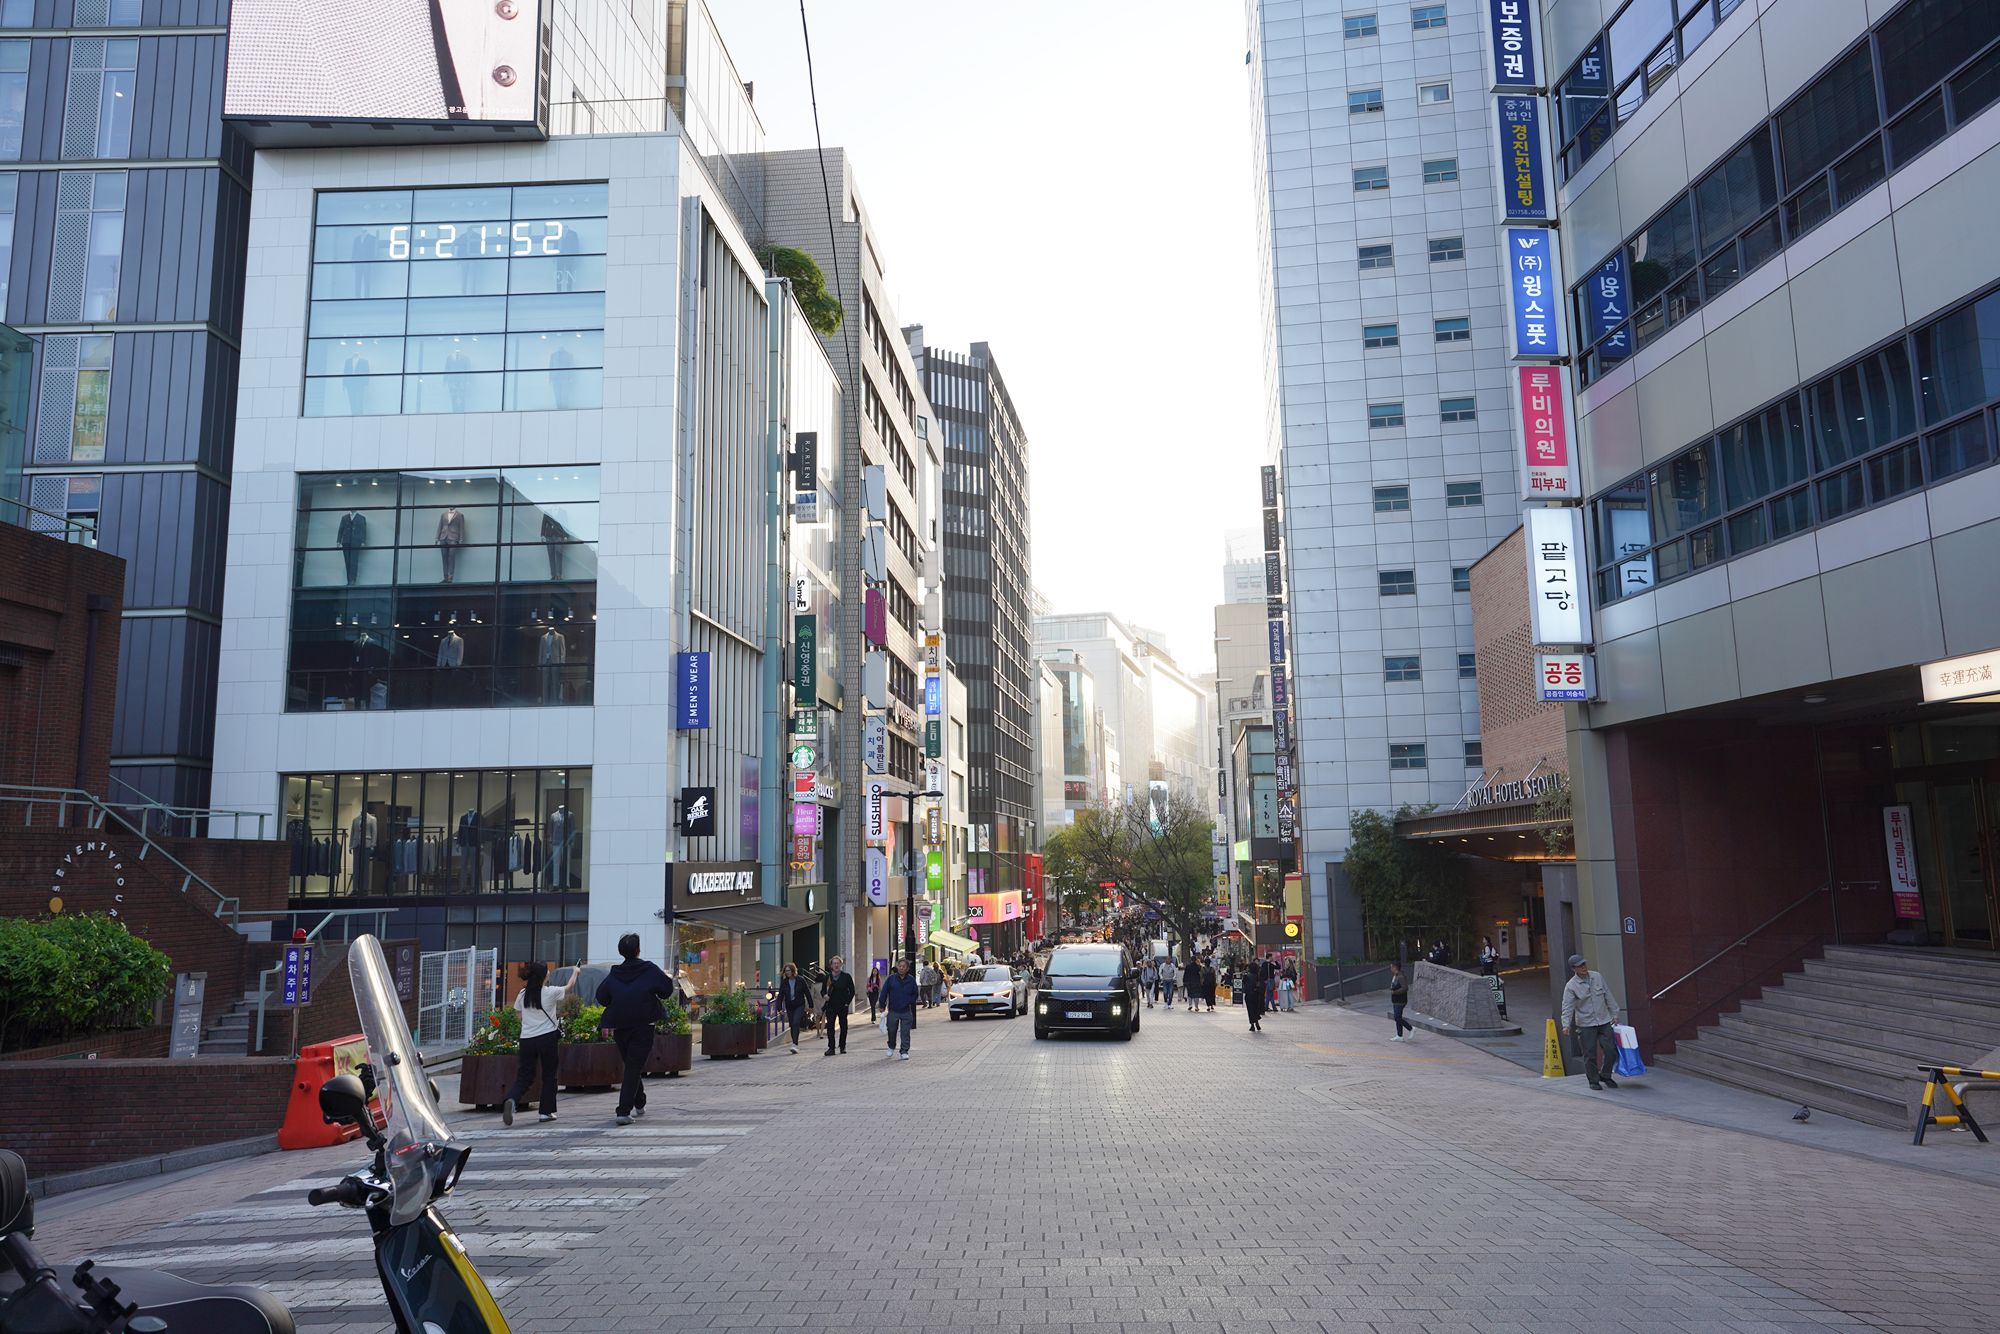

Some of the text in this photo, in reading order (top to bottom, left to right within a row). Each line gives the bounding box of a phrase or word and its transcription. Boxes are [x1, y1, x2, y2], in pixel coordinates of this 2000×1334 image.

[1499, 2, 1524, 78] 보증권
[1505, 111, 1532, 122] 법인
[1511, 124, 1533, 206] 경진컨설팅
[389, 221, 563, 259] 6:21:52
[1519, 255, 1542, 272] (주)
[1522, 275, 1547, 346] 윙스풋
[1530, 372, 1556, 460] 루비의원
[1530, 477, 1567, 491] 피부과
[800, 641, 811, 687] 신영증권
[928, 646, 938, 667] 치과
[1545, 662, 1582, 685] 공증
[1939, 664, 1993, 687] 幸運充滿
[689, 655, 698, 717] MEN'S WEAR
[1546, 690, 1564, 698] 공증인
[867, 737, 876, 760] 치과
[1467, 786, 1493, 809] ROYAL
[1495, 780, 1525, 803] HOTEL
[687, 810, 709, 820] BERRY
[690, 805, 705, 813] OAK
[871, 784, 881, 836] SUSHIRO
[689, 871, 754, 896] OAKBERRY AÇAI
[871, 878, 881, 896] CU
[400, 1253, 433, 1282] Vespa
